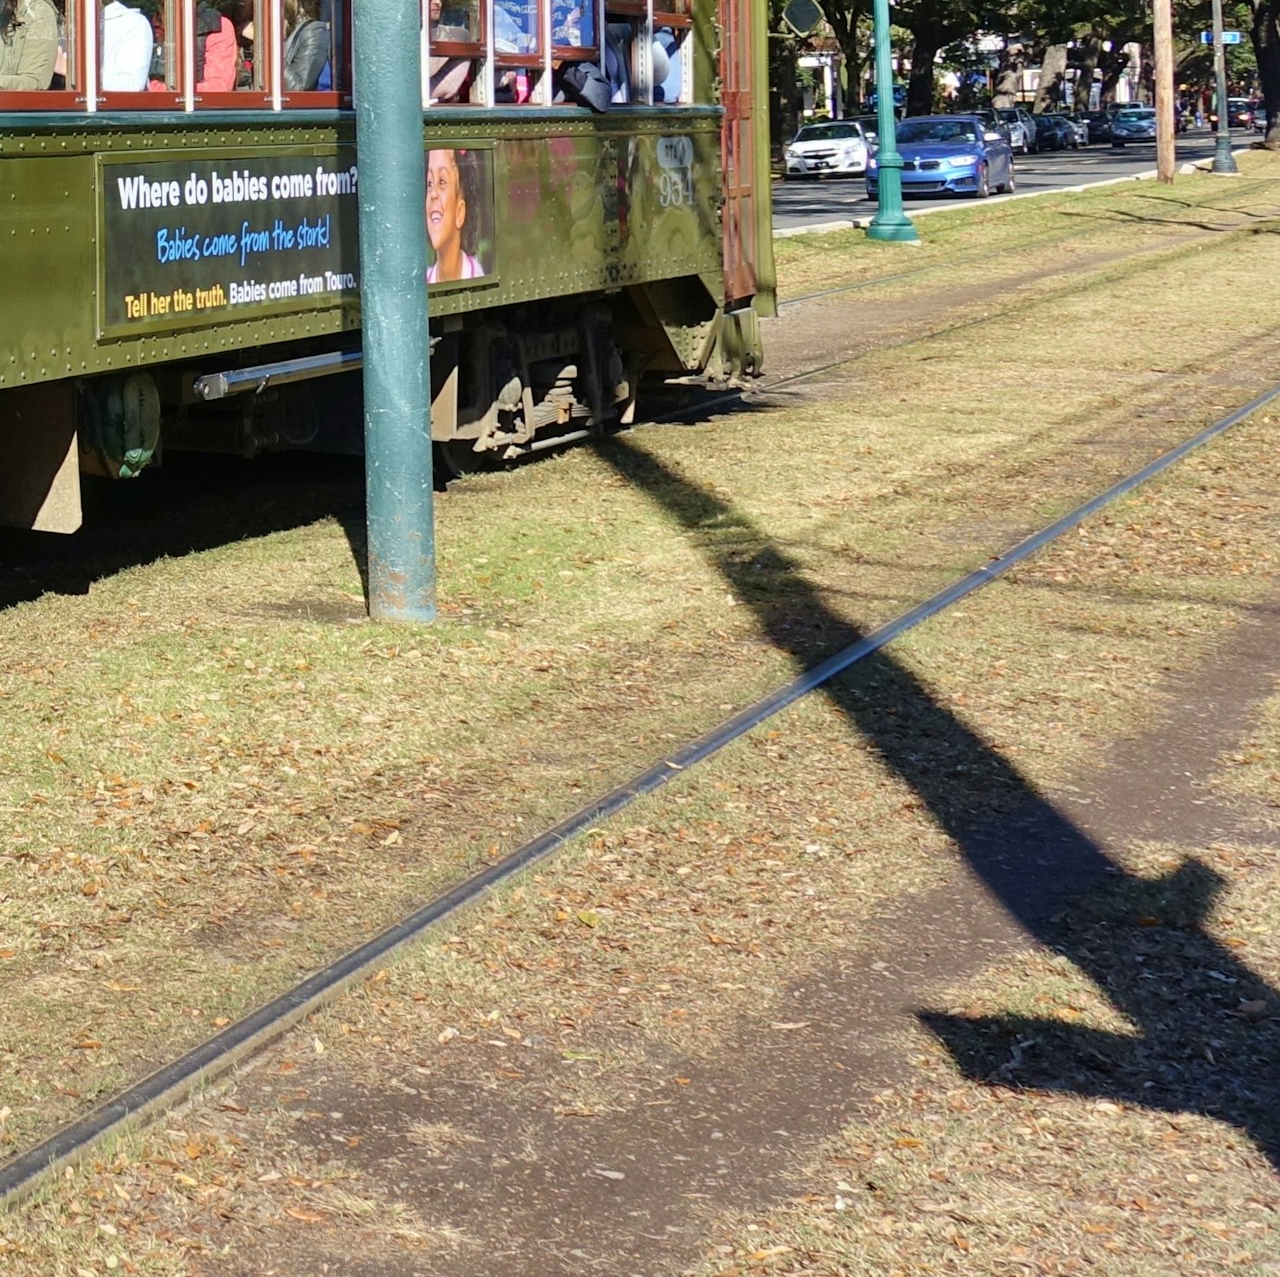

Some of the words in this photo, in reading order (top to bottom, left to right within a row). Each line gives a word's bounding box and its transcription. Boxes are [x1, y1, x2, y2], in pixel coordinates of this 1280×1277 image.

[664, 144, 677, 160] RTA
[117, 175, 180, 210] Where
[184, 173, 207, 205] do
[212, 170, 268, 203] babies
[272, 176, 313, 199] come
[317, 166, 358, 195] from?
[658, 167, 694, 207] 954
[157, 227, 200, 264] Babies
[203, 233, 237, 257] come
[240, 221, 270, 266] from
[272, 220, 295, 250] the
[297, 214, 331, 250] stork!
[125, 293, 148, 318] Tell
[151, 291, 171, 314] her
[173, 289, 193, 312] the
[196, 284, 227, 308] truth.
[229, 281, 267, 304] Babies
[268, 279, 298, 299] come
[299, 273, 323, 295] from
[324, 271, 357, 291] Touro.
